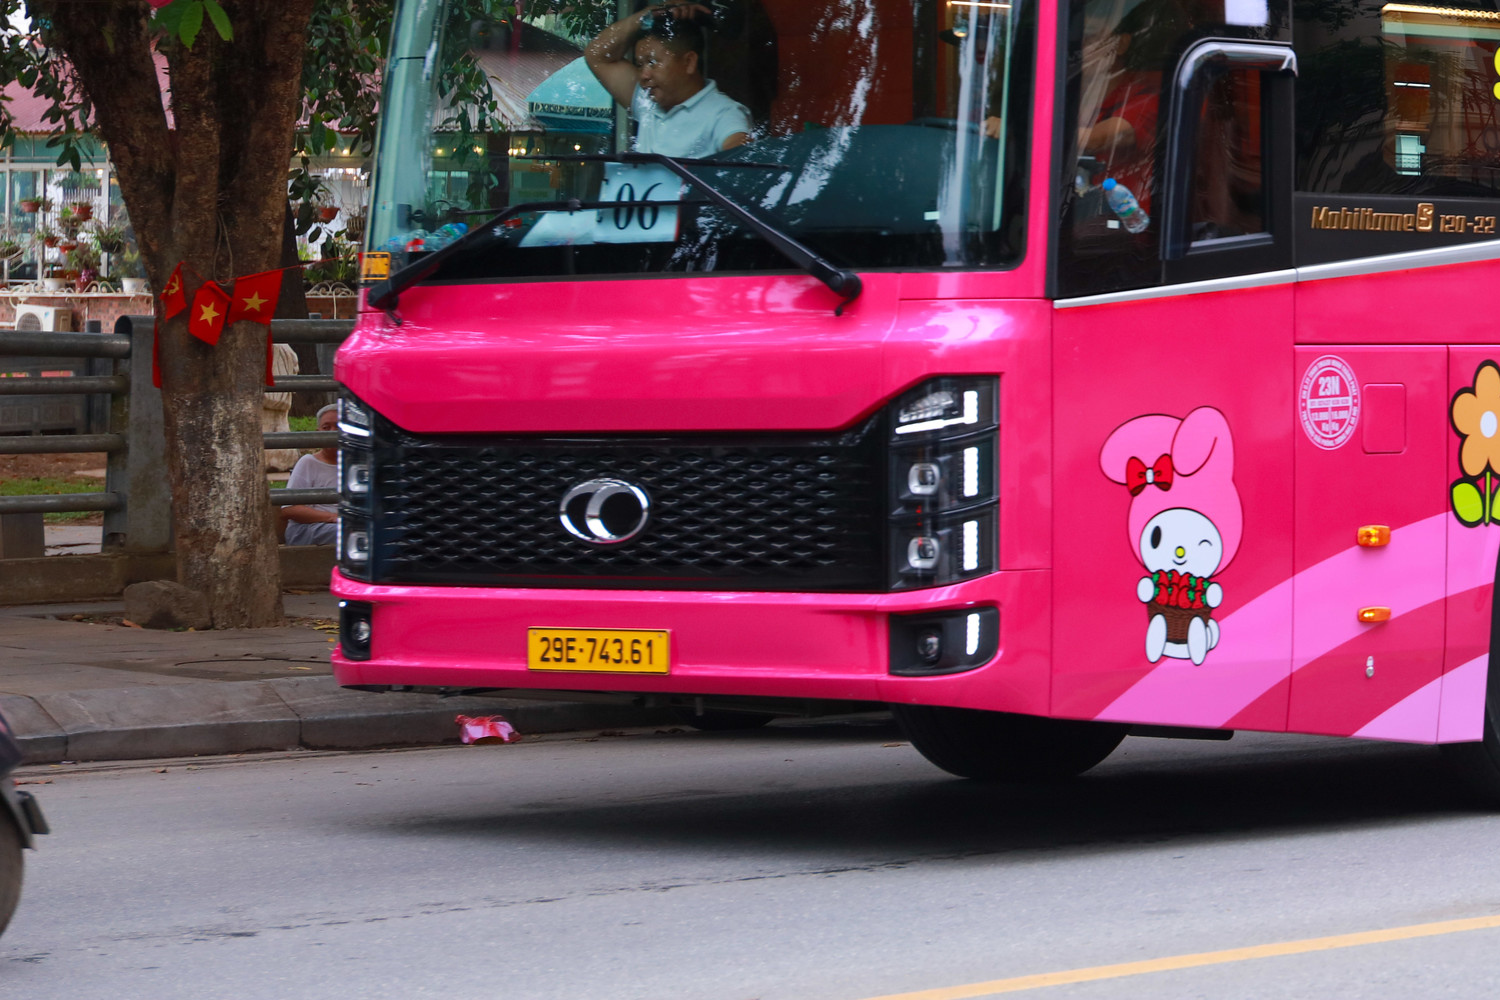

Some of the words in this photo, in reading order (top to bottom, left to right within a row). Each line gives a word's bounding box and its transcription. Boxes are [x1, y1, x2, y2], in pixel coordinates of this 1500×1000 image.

[613, 182, 663, 230] 06
[1439, 214, 1497, 234] 120-22
[540, 636, 653, 665] 29E-743.61
